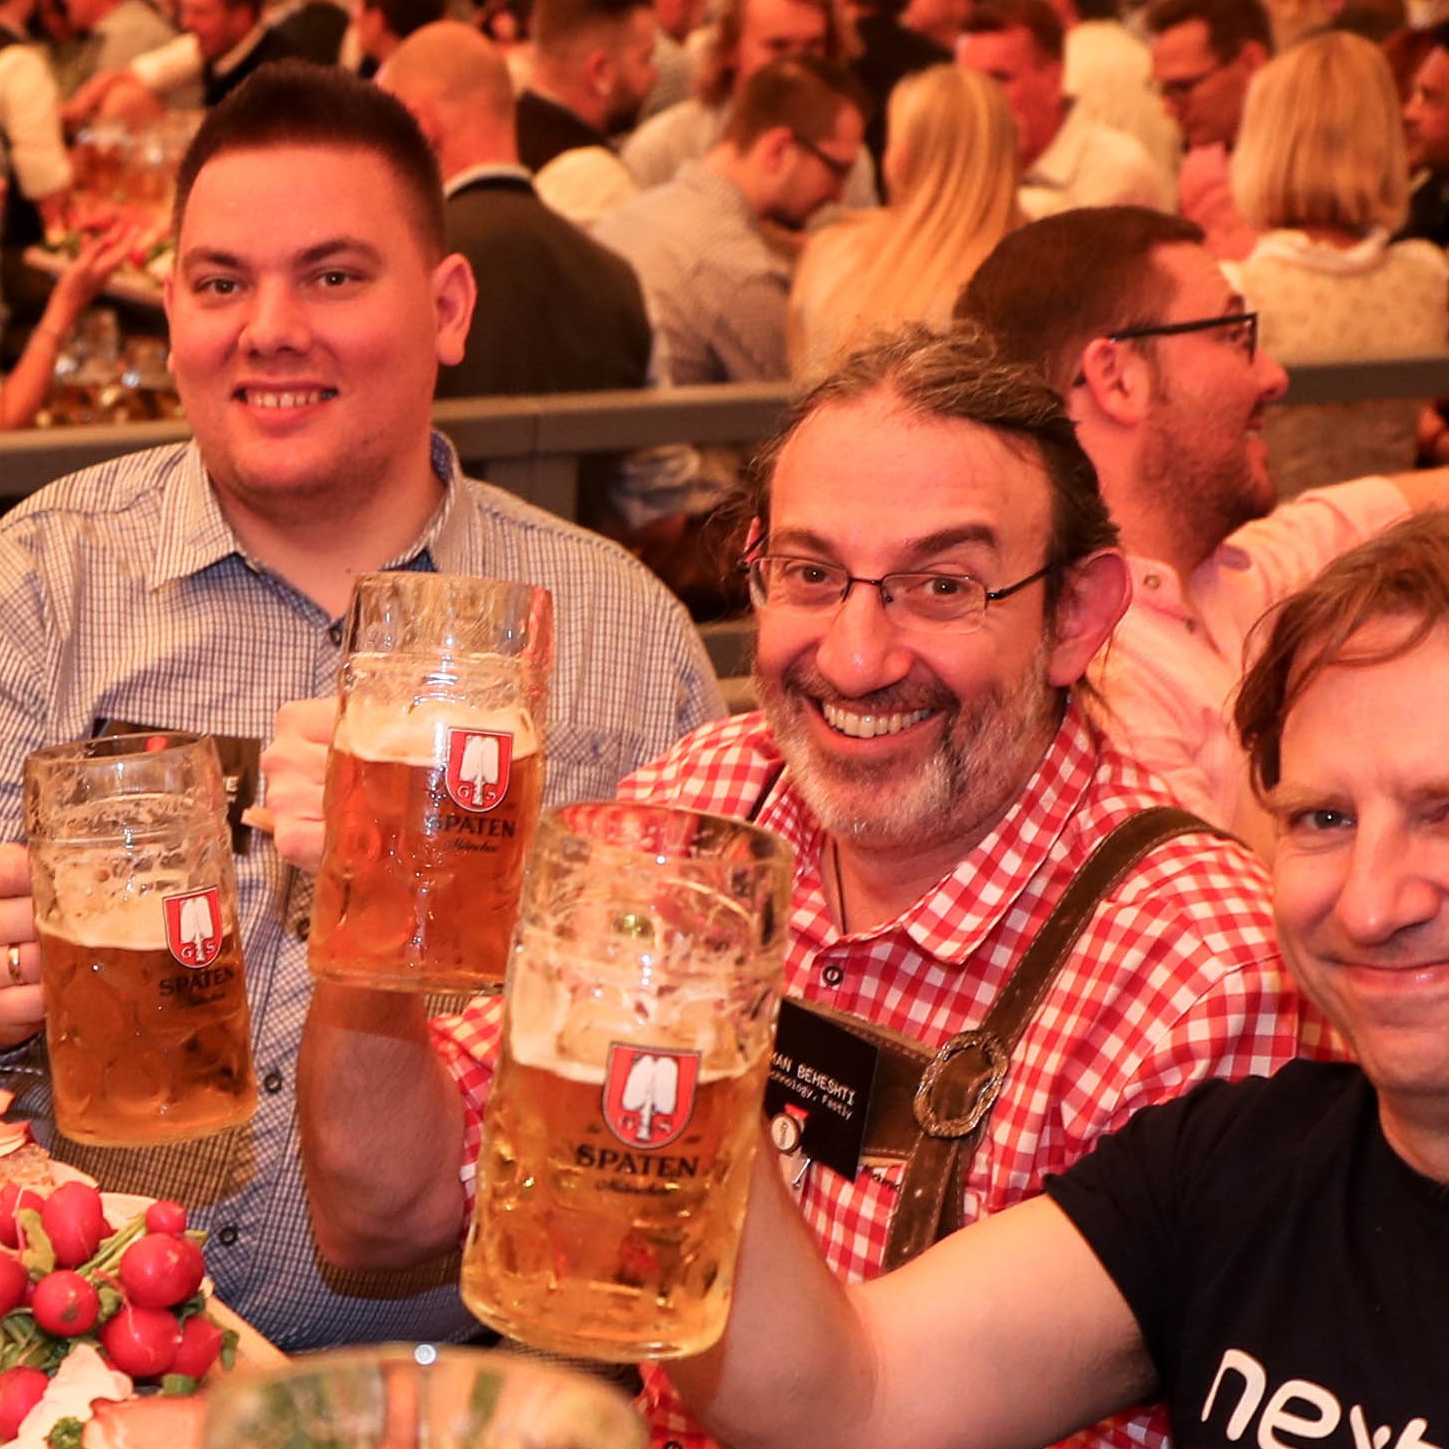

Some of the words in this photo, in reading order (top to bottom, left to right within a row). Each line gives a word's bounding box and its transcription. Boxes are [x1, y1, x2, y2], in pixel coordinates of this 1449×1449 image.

[429, 812, 517, 838] SPATEN
[159, 965, 235, 997] SPATEN
[797, 1063, 855, 1105] BEHESHTI
[575, 1143, 700, 1178] SPATEN
